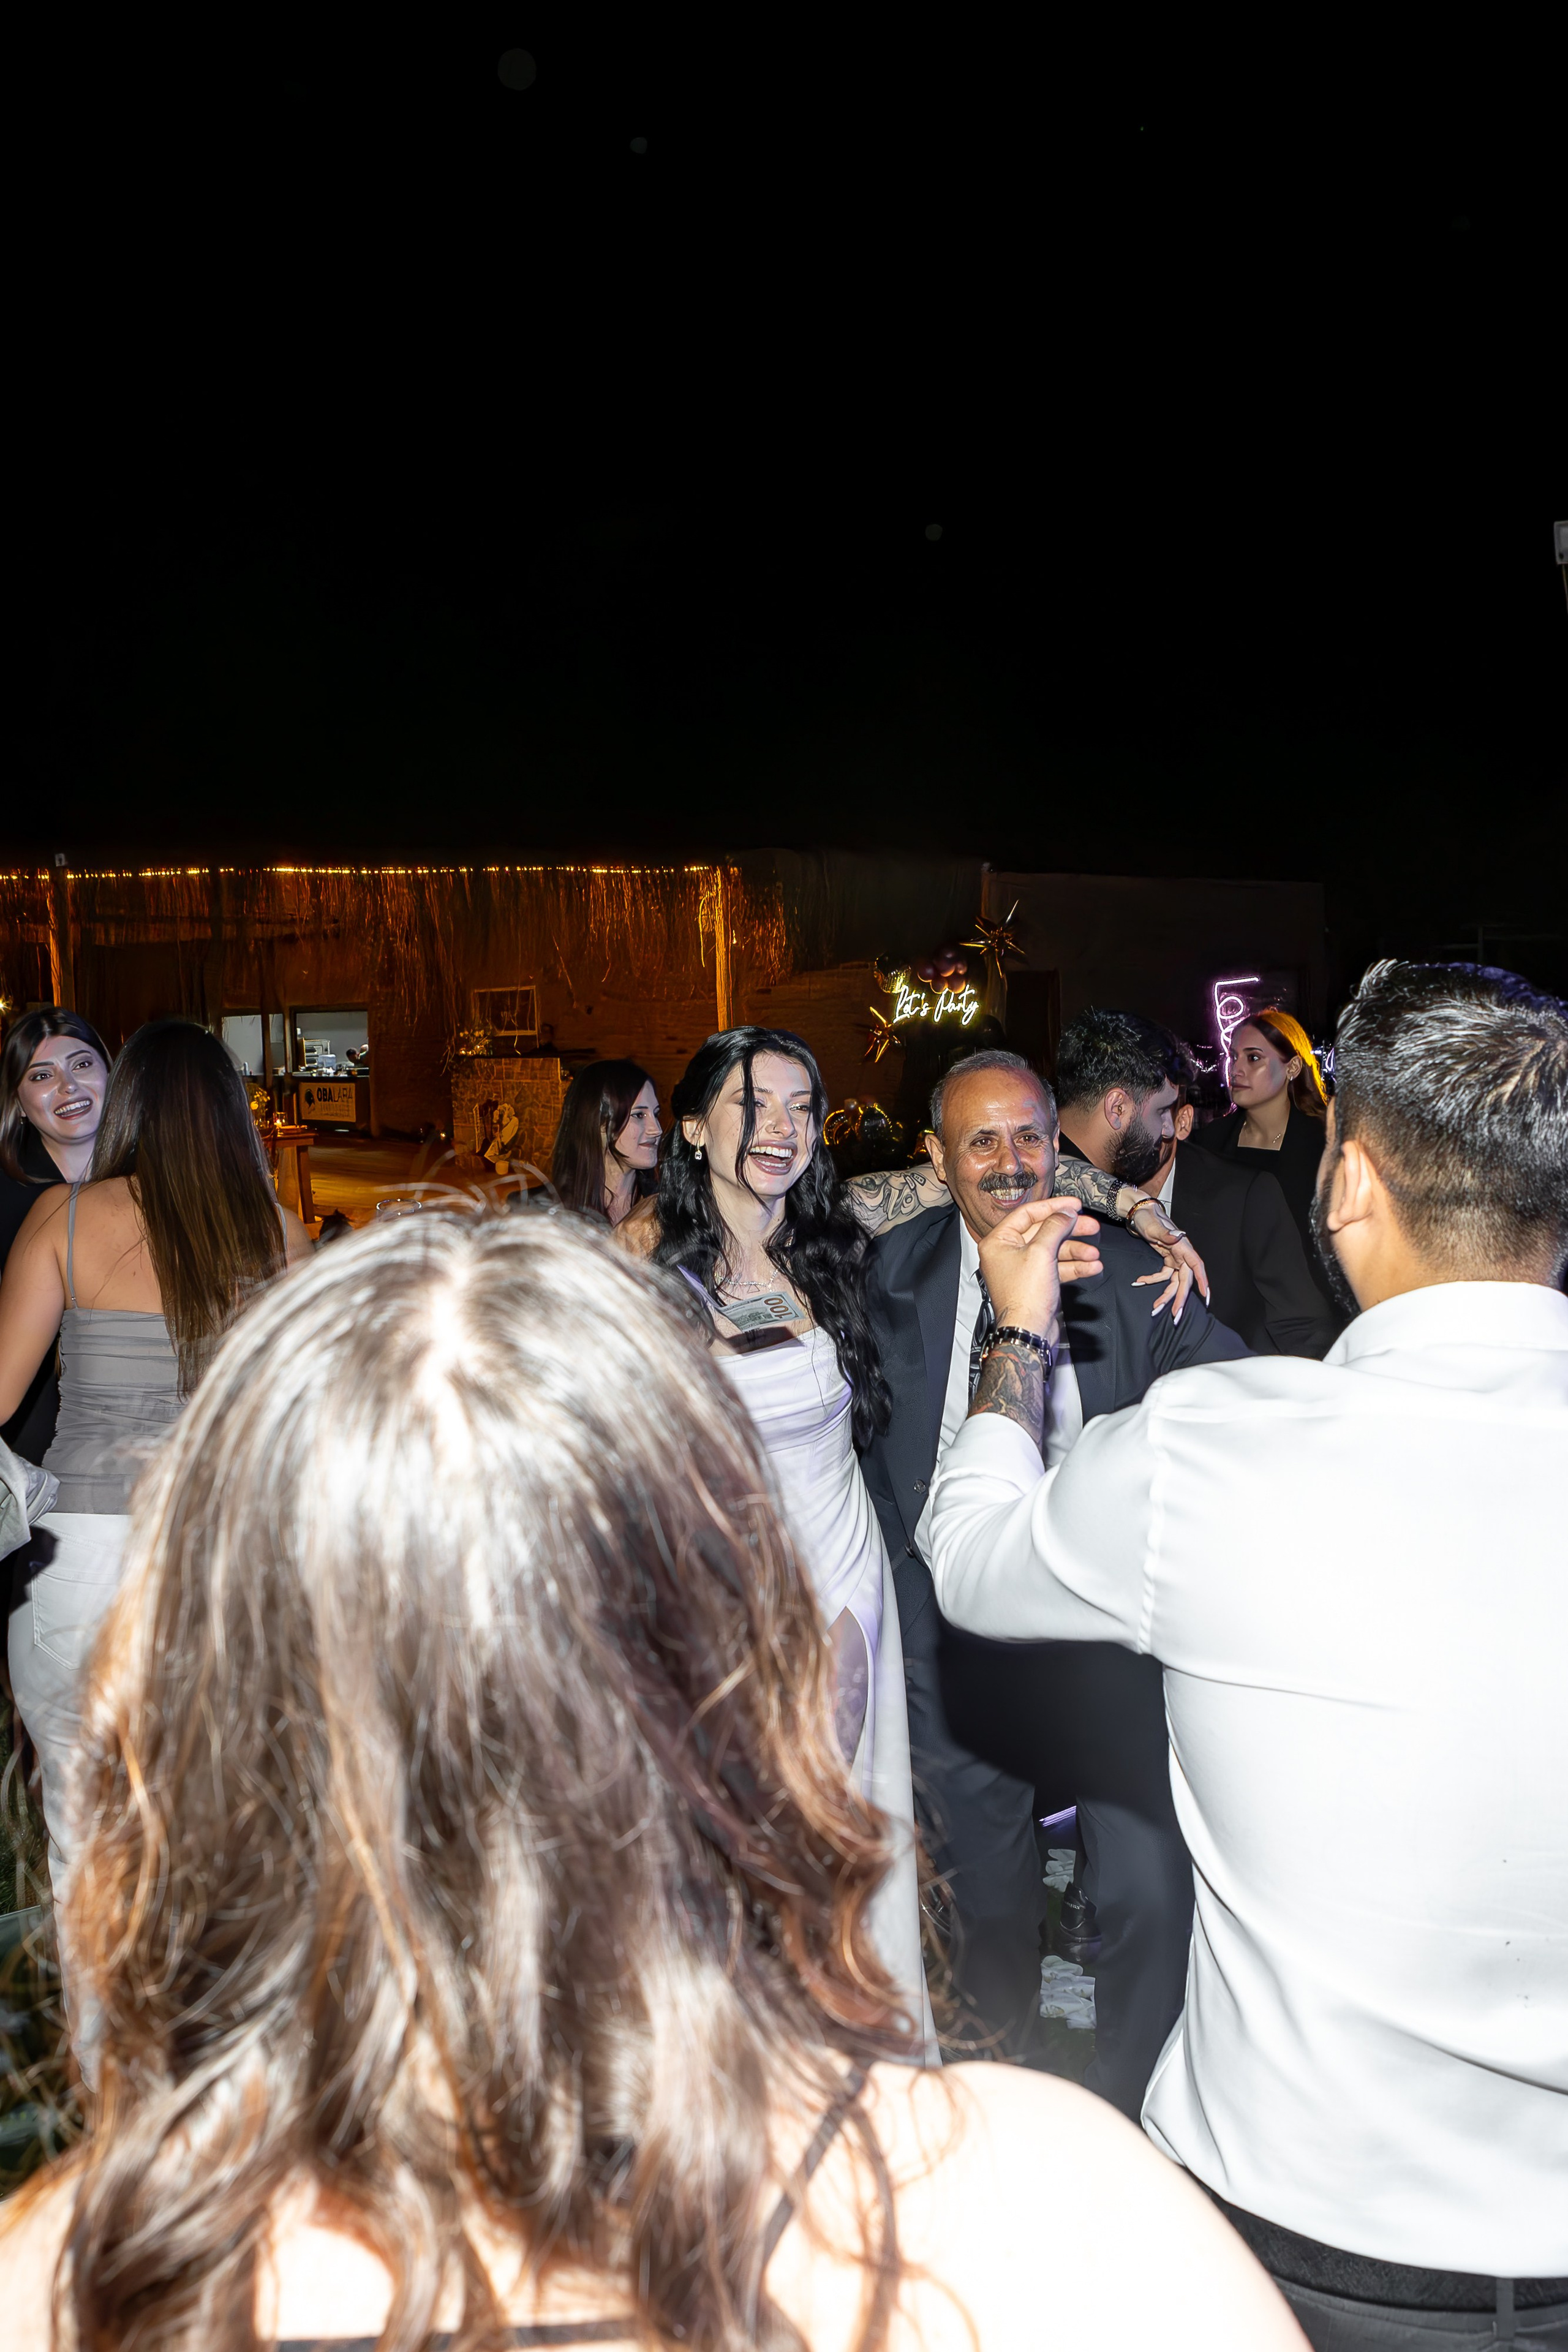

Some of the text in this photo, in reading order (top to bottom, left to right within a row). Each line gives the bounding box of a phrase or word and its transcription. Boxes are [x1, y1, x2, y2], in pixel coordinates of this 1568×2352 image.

[893, 984, 979, 1025] Let's Party
[764, 1297, 793, 1319] 100
